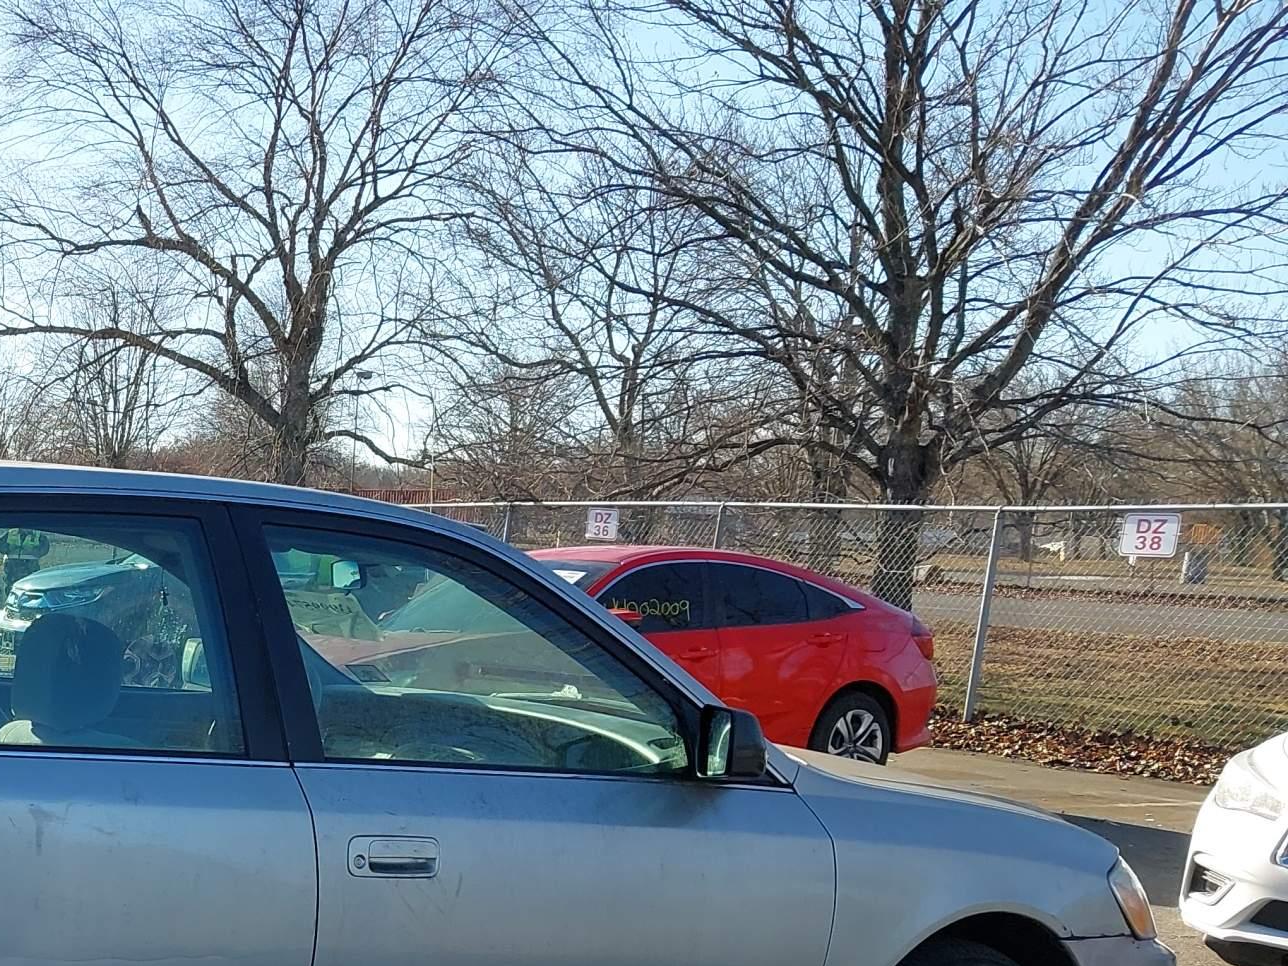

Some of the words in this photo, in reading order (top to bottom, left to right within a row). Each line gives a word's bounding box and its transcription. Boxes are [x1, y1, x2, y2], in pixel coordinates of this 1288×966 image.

[594, 512, 613, 524] DZ
[593, 525, 609, 537] 36
[1136, 519, 1168, 534] DZ
[1134, 536, 1162, 551] 38
